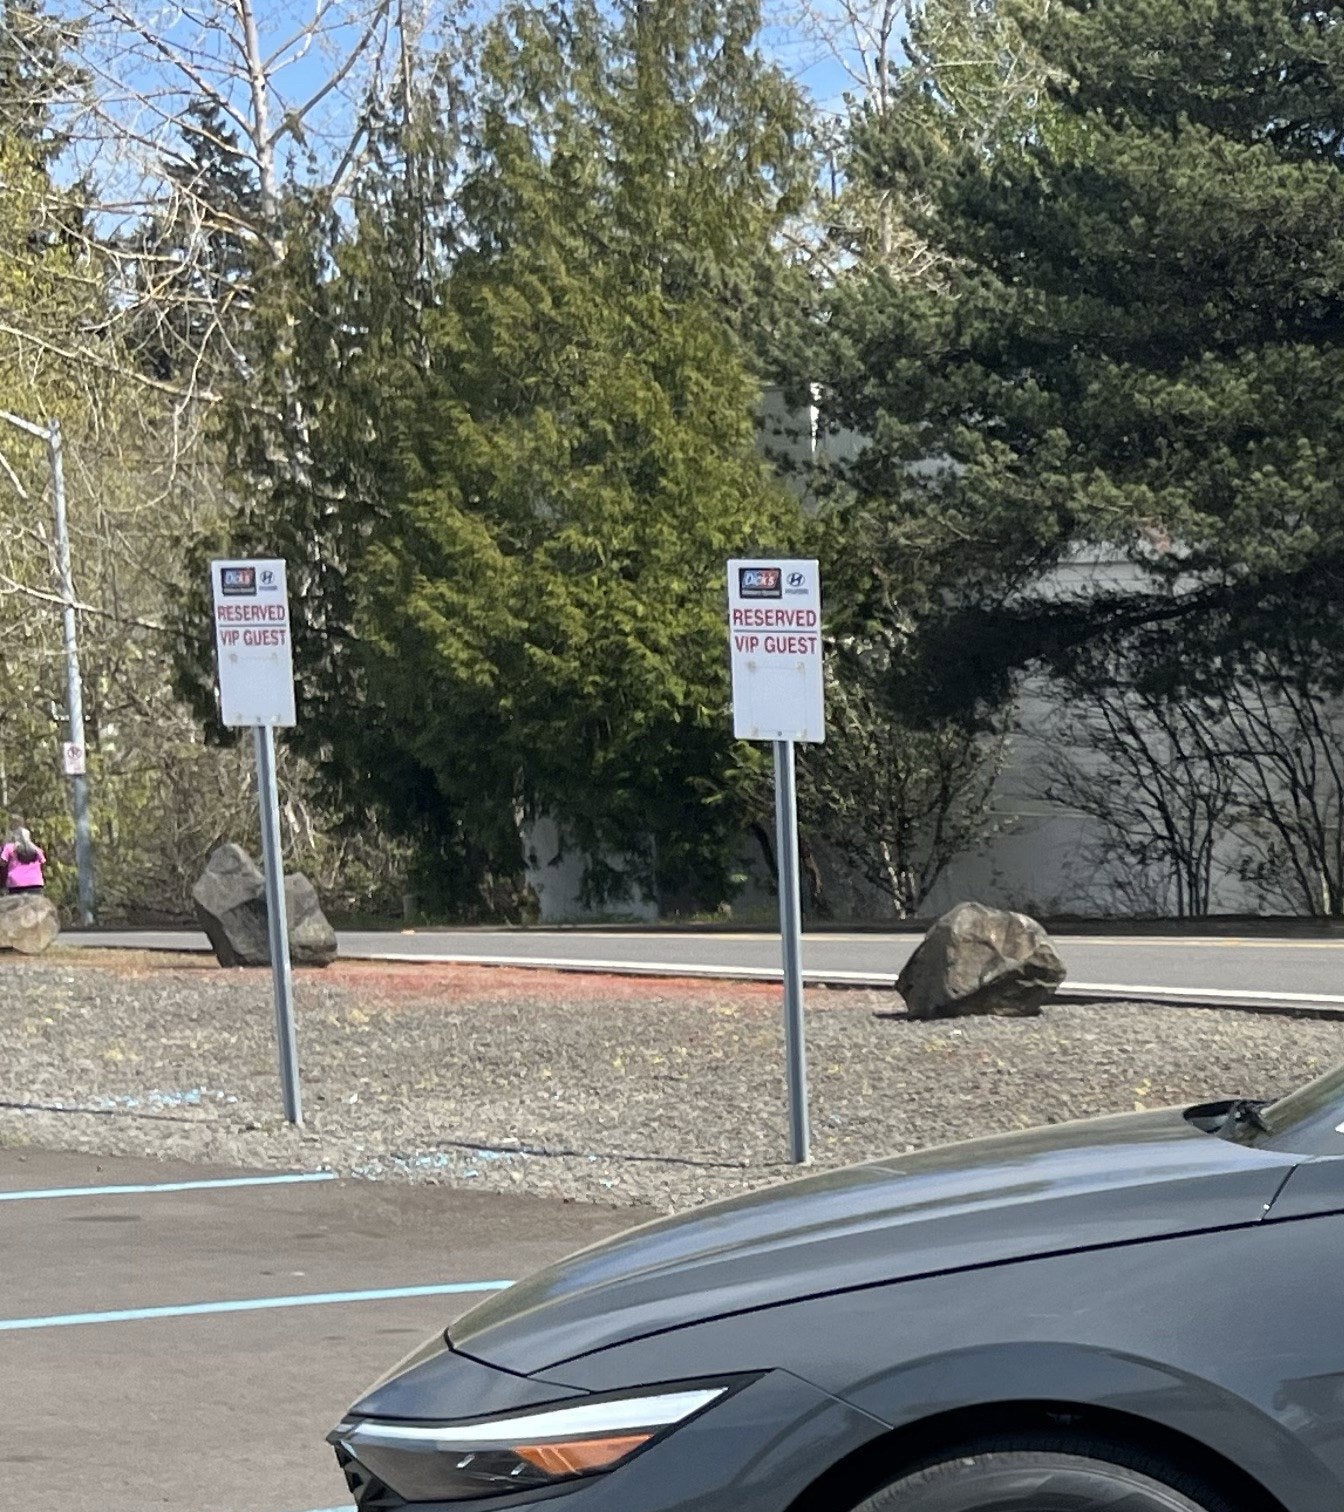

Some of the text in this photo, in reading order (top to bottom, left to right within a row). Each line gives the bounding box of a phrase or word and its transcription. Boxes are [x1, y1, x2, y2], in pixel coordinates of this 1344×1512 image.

[217, 604, 286, 621] RESERVED
[732, 608, 817, 627] RESERVED
[220, 629, 287, 646] VIP GUEST
[734, 635, 818, 655] VIP GUEST
